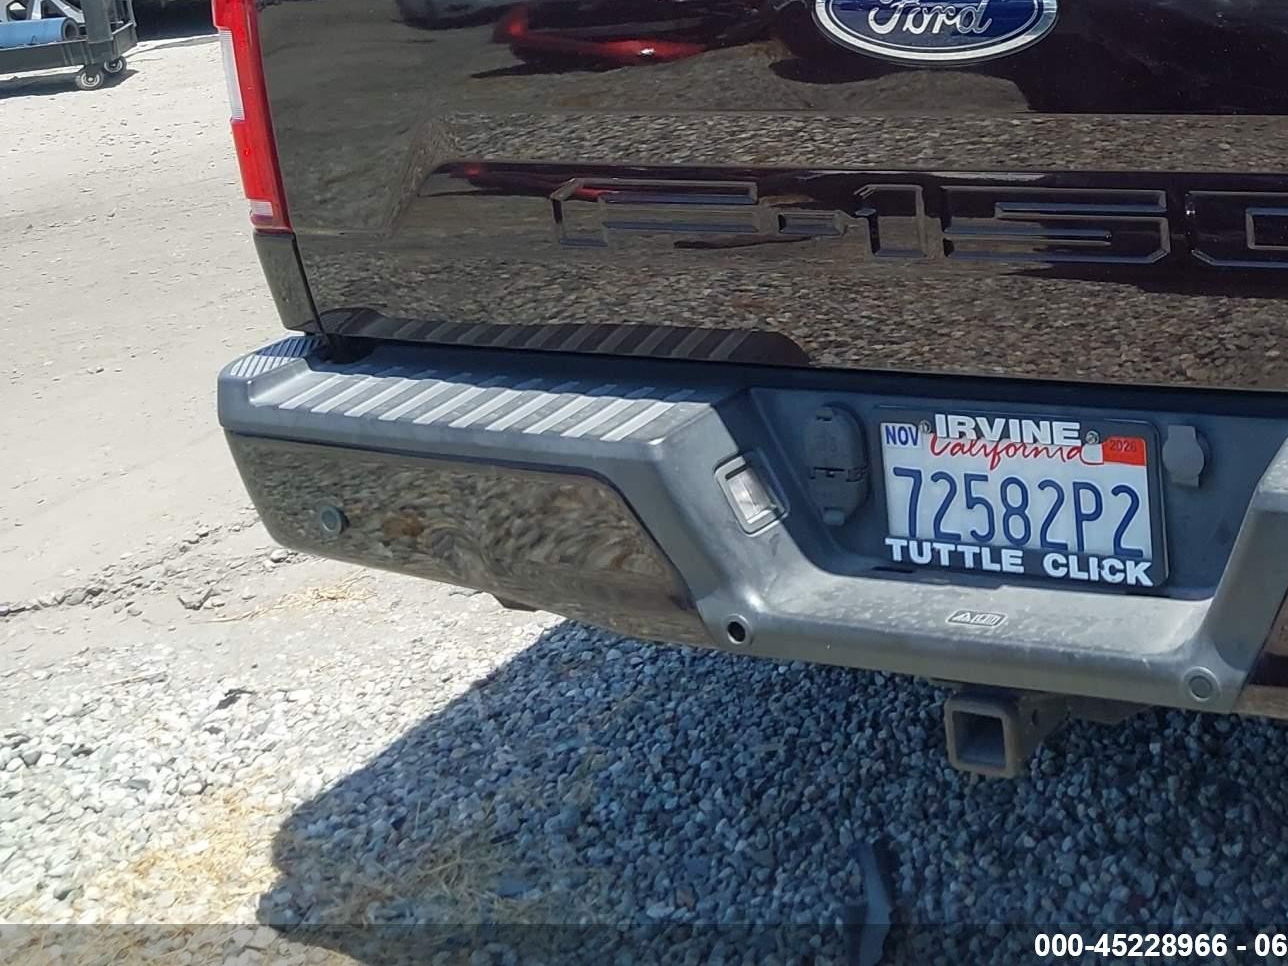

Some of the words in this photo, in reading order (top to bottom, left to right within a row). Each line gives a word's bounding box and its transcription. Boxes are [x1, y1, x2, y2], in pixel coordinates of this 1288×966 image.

[885, 425, 918, 446] NOV
[934, 413, 1082, 445] IRVINE
[929, 436, 1104, 471] California
[893, 466, 1143, 558] 72582P2
[885, 537, 1025, 574] TUTTLE
[1042, 552, 1153, 586] CLICK
